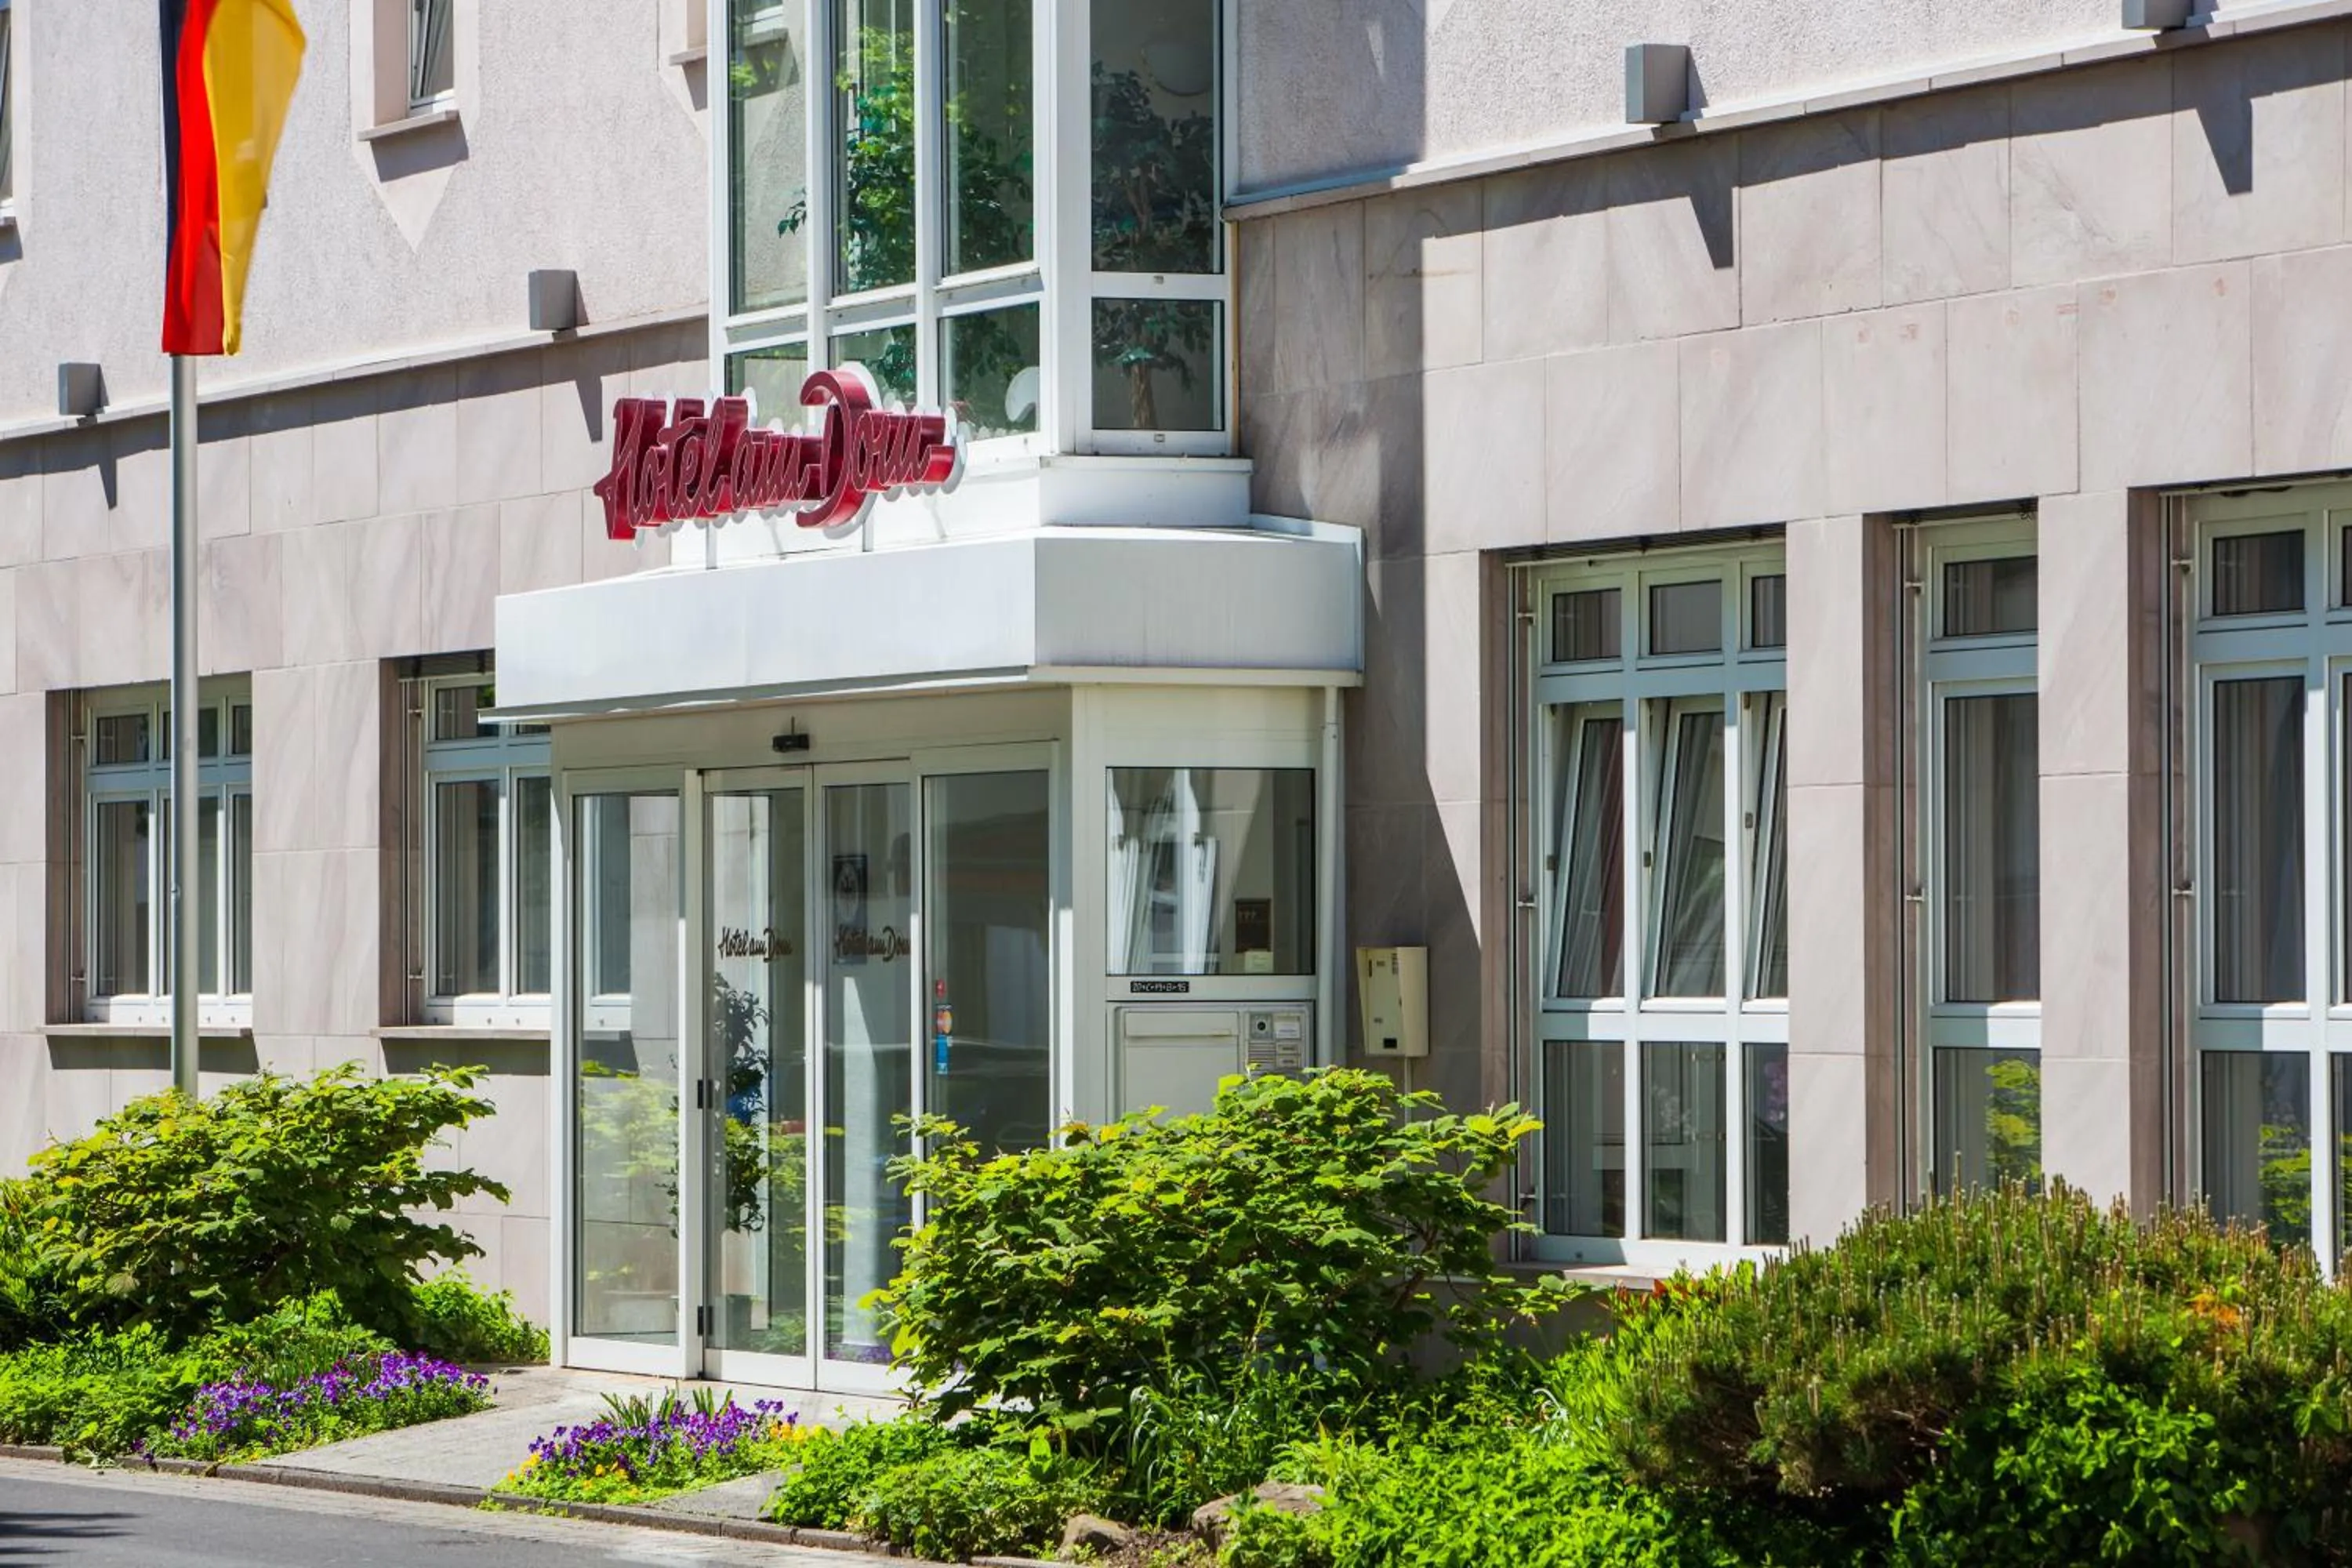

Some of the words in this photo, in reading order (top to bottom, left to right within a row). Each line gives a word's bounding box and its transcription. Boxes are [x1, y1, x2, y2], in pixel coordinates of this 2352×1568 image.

[593, 396, 745, 539] Hotel
[731, 428, 822, 511] am
[796, 370, 956, 528] Dom
[717, 926, 749, 960] Hotel
[749, 938, 767, 957] am
